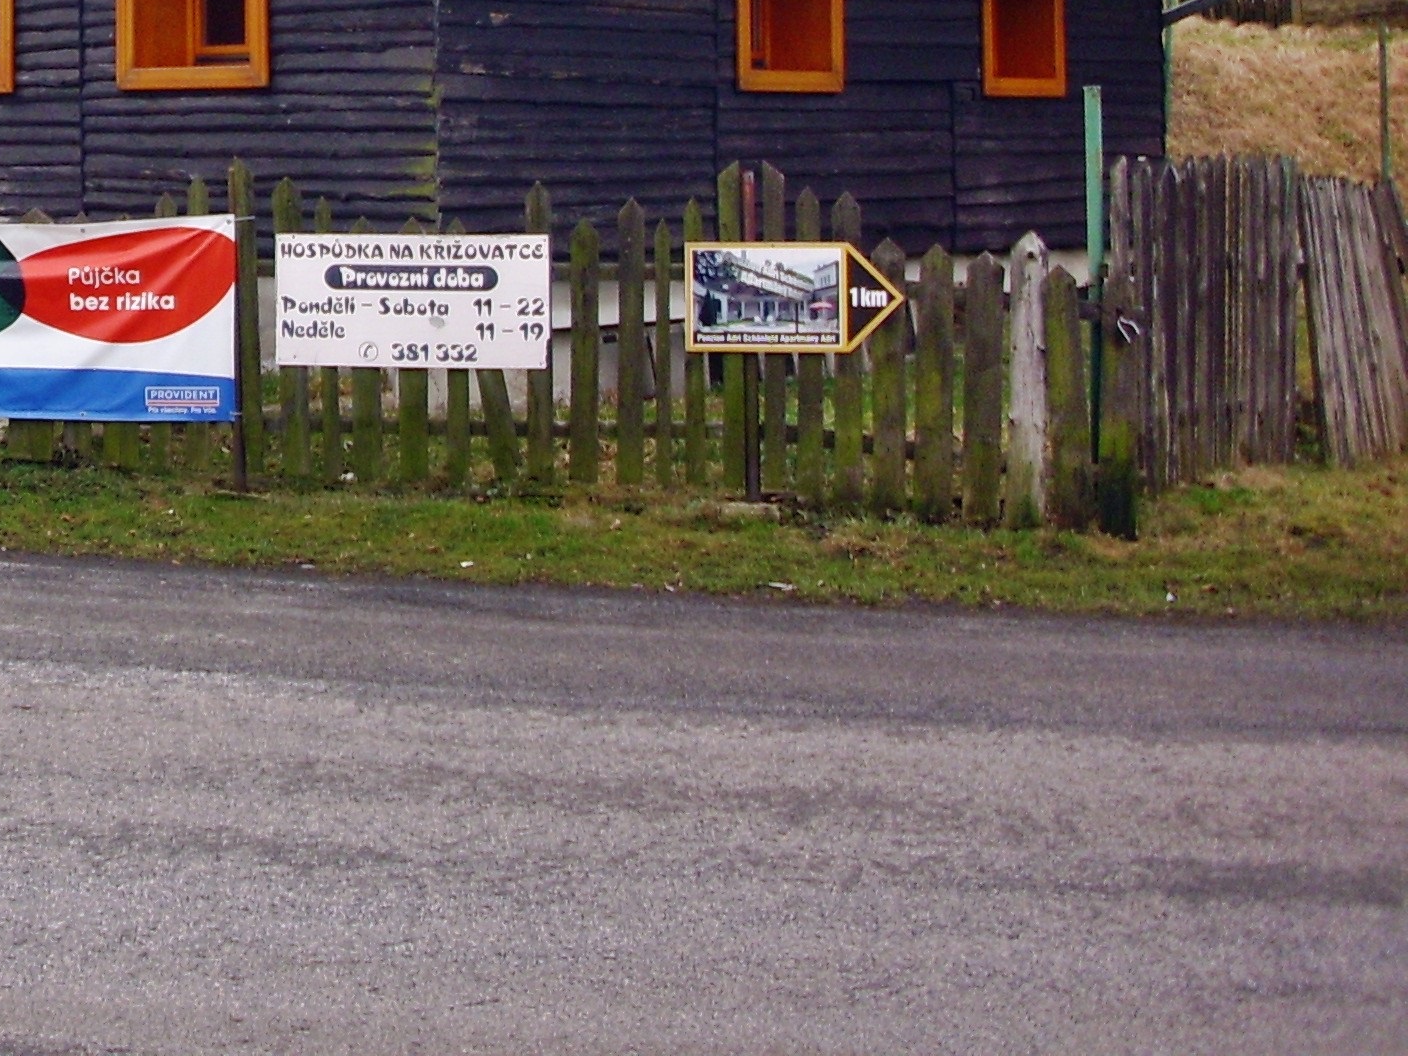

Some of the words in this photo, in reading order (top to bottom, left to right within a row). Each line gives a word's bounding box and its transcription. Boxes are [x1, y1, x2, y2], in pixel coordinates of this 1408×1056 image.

[280, 238, 384, 260] HOSPŮDKA
[389, 244, 414, 260] NA
[419, 240, 545, 260] KŘIŽOVATCE
[68, 266, 141, 289] Půjčka
[339, 266, 429, 288] Provozní
[433, 267, 484, 288] doba
[69, 292, 110, 311] bez
[116, 291, 175, 311] rizika
[378, 297, 450, 317] Sobota
[473, 297, 493, 317] 11
[517, 297, 546, 317] 22
[849, 287, 858, 307] 1
[860, 287, 888, 307] km
[281, 319, 346, 339] Neděle
[475, 322, 495, 342] 11
[518, 322, 545, 342] 19
[391, 342, 429, 362] 381
[436, 343, 478, 363] 332
[150, 389, 216, 400] PROVIDENT
